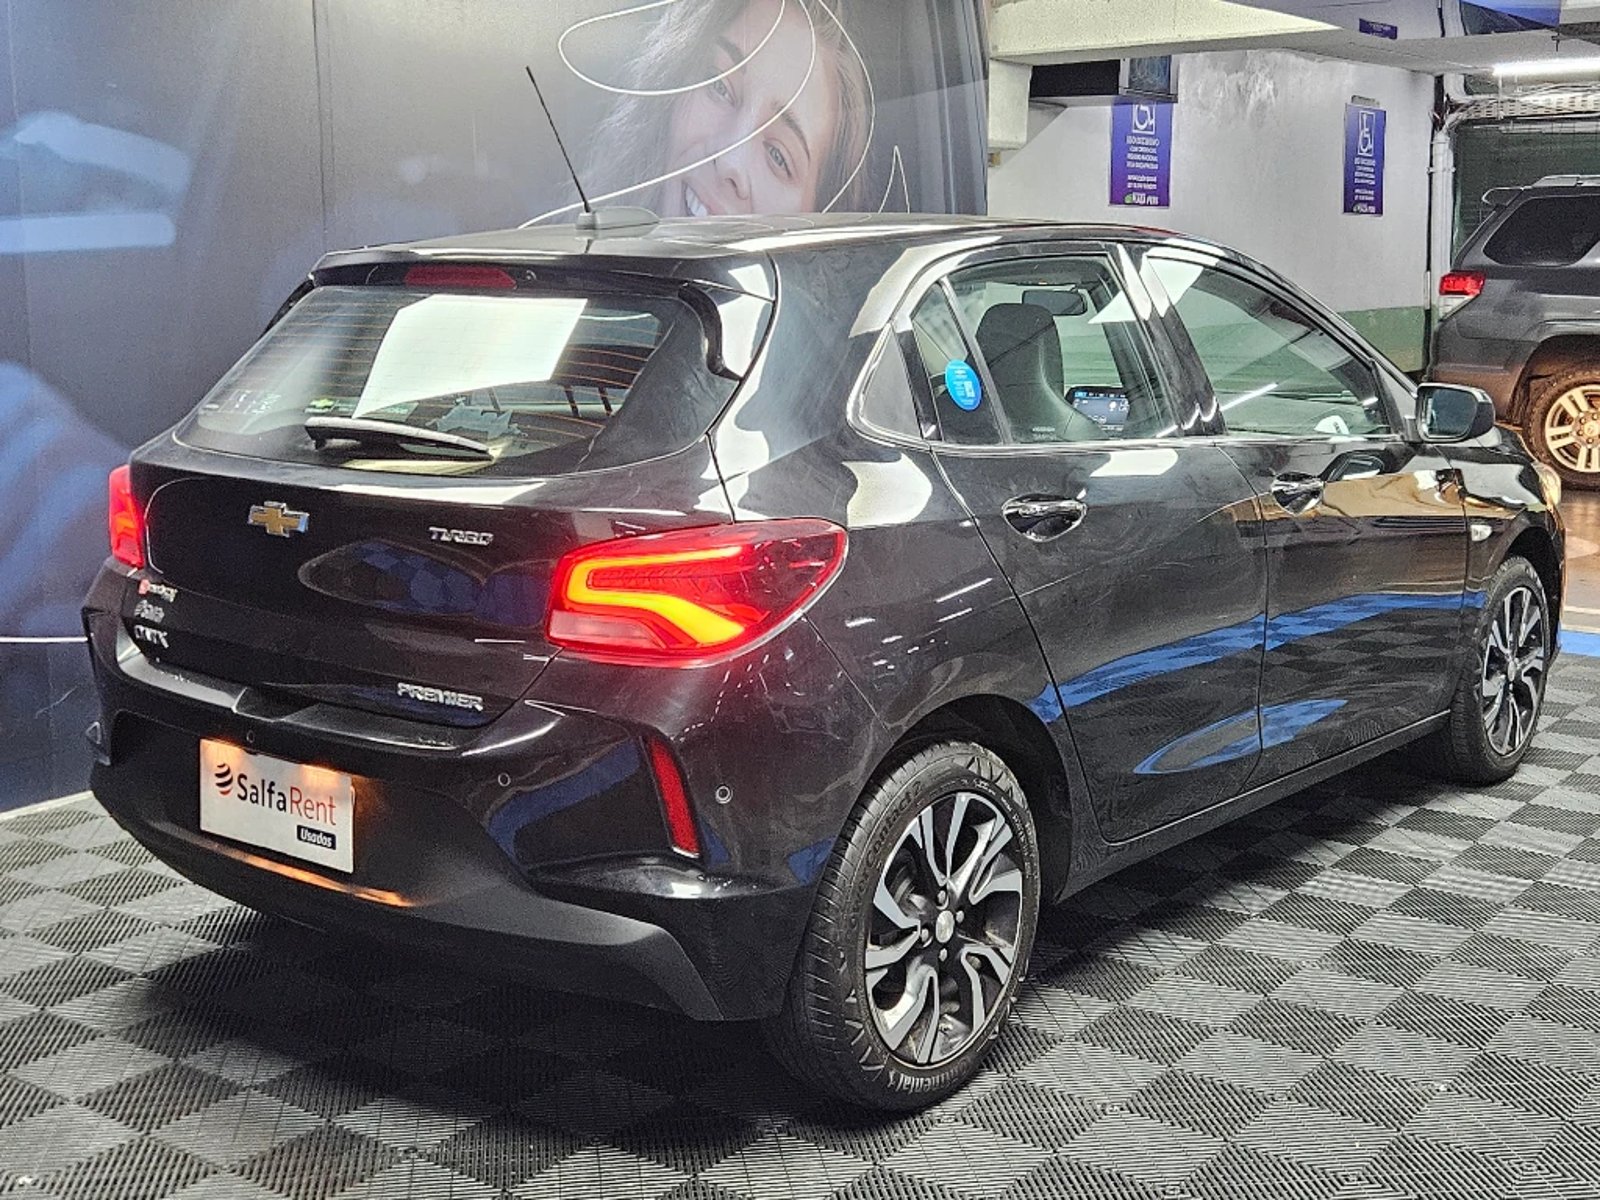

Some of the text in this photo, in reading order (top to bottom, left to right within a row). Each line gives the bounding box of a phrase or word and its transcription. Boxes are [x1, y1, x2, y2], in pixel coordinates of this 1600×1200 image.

[429, 526, 494, 546] TURBO
[397, 682, 484, 712] PREMIER
[237, 773, 337, 826] SalfaRent
[300, 828, 333, 848] Usados
